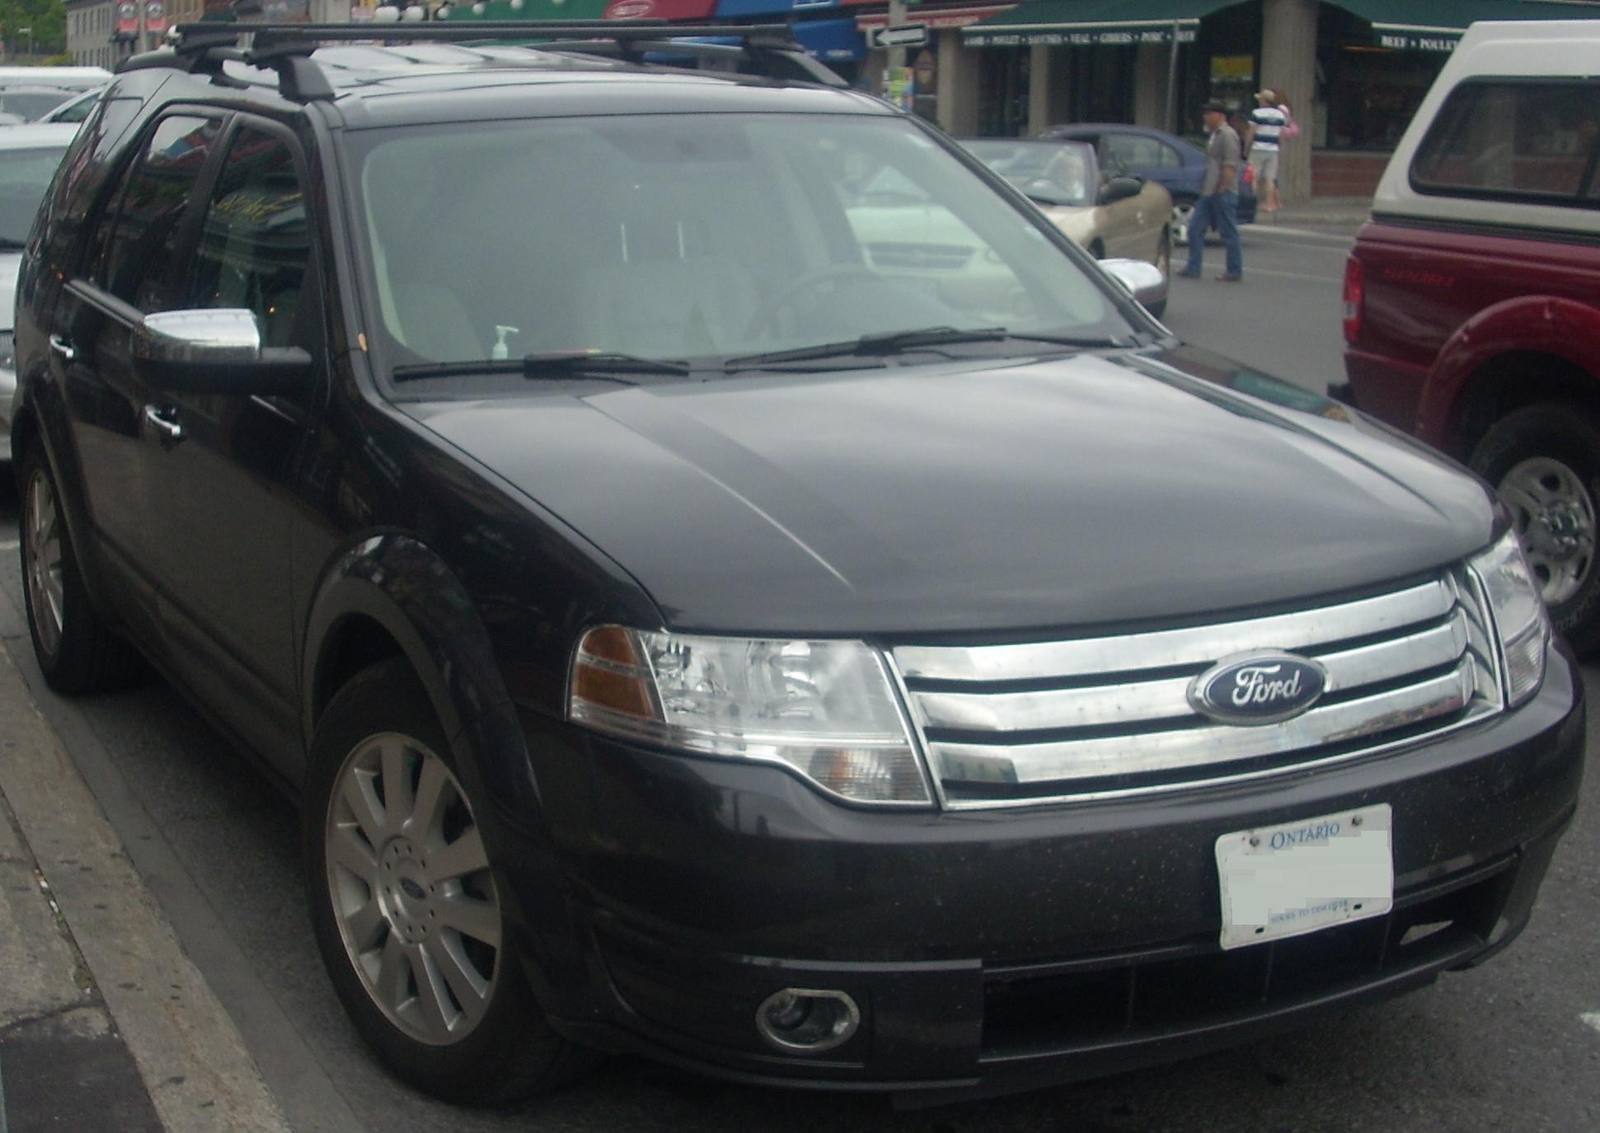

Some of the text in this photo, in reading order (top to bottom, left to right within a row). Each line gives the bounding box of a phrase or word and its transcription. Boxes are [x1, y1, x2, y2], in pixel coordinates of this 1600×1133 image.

[1381, 35, 1407, 49] BEEF
[1232, 664, 1301, 706] Ford
[1270, 822, 1340, 849] ONTARIO
